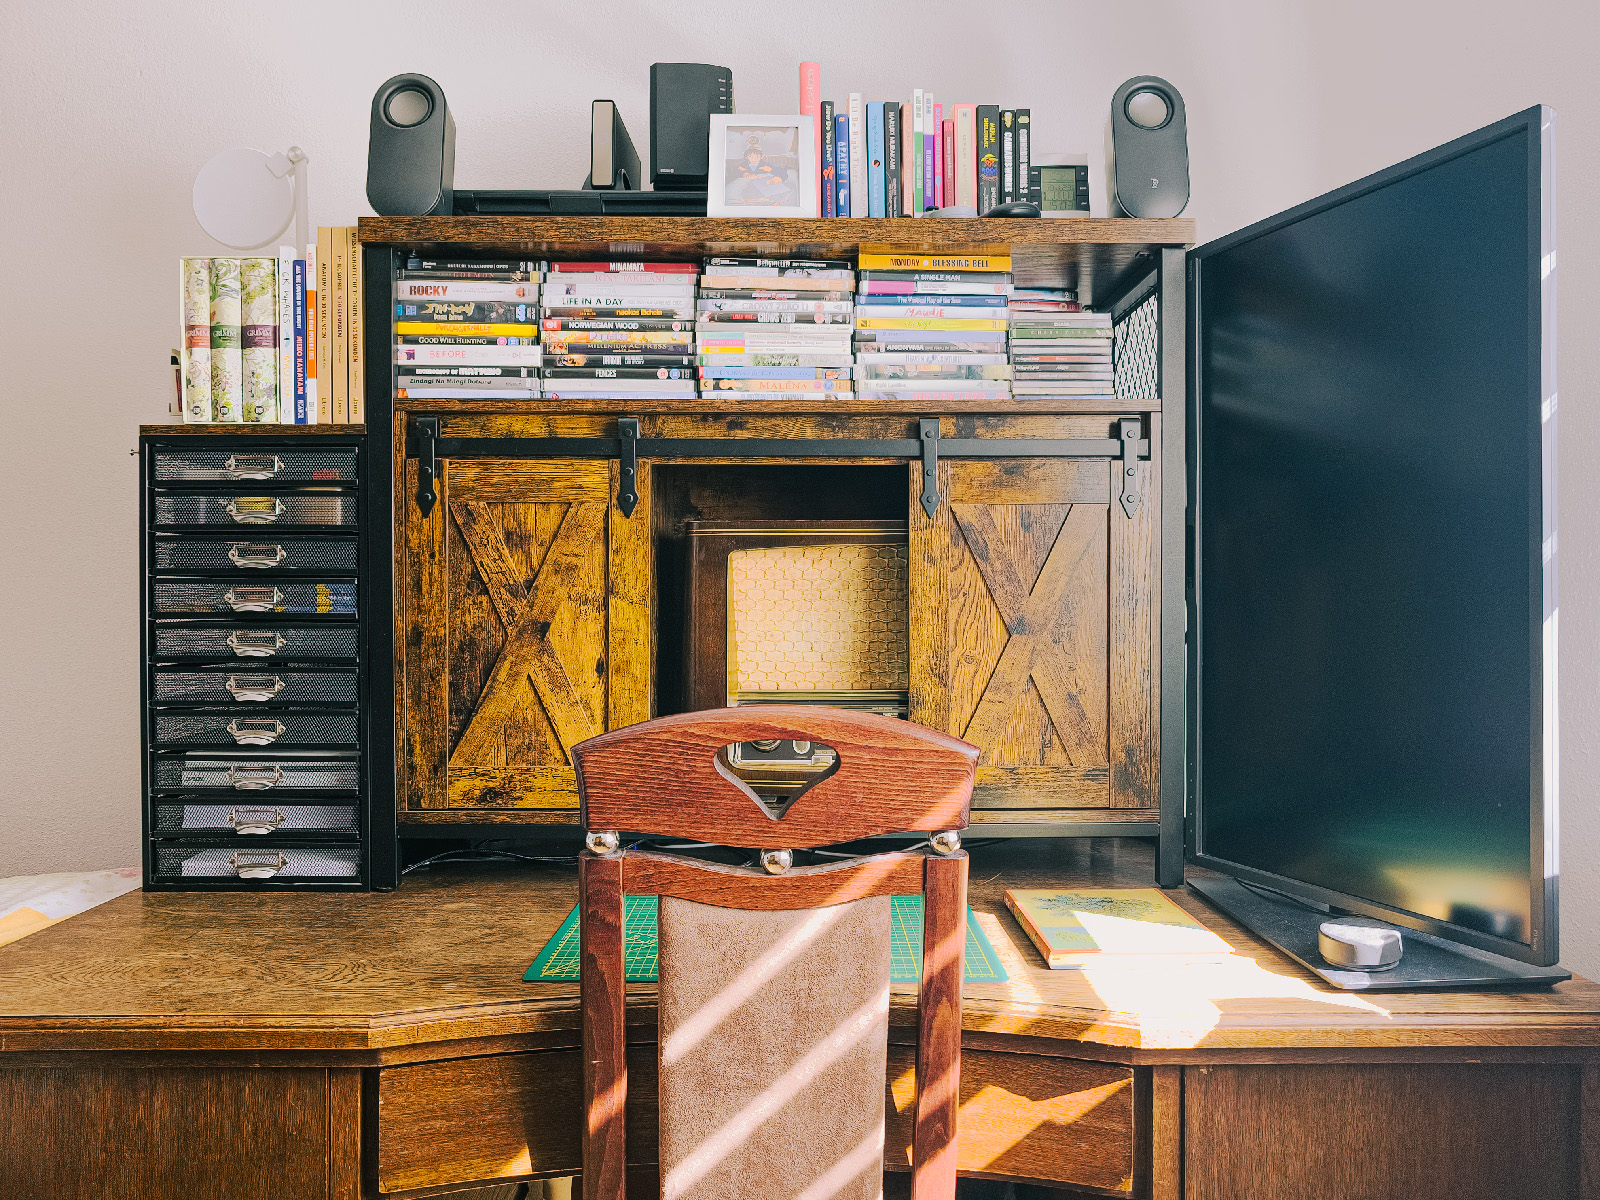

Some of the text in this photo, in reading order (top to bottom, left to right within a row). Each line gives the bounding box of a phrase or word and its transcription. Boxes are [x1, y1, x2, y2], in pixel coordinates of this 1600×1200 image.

[852, 118, 859, 127] Be
[825, 105, 833, 162] How Do You Live?
[838, 142, 848, 174] APATHY
[1004, 132, 1012, 192] CANNABIS WORKS
[1019, 163, 1028, 188] WORKS
[610, 262, 644, 272] MINAMATA
[932, 259, 969, 267] BLESSING
[409, 286, 448, 296] ROCKY
[926, 296, 935, 305] Ray
[283, 290, 291, 324] WHALES
[742, 302, 773, 310] CROWS
[776, 302, 800, 310] ZERO
[758, 312, 780, 323] CROWS
[213, 328, 236, 337] GRIMM
[247, 328, 272, 337] GRIMM
[589, 331, 628, 341] Paprika
[429, 350, 466, 358] BEFORE
[284, 356, 292, 397] MADDOX
[595, 369, 617, 378] FENCES
[932, 392, 955, 400] YEN
[958, 392, 987, 400] LOVE
